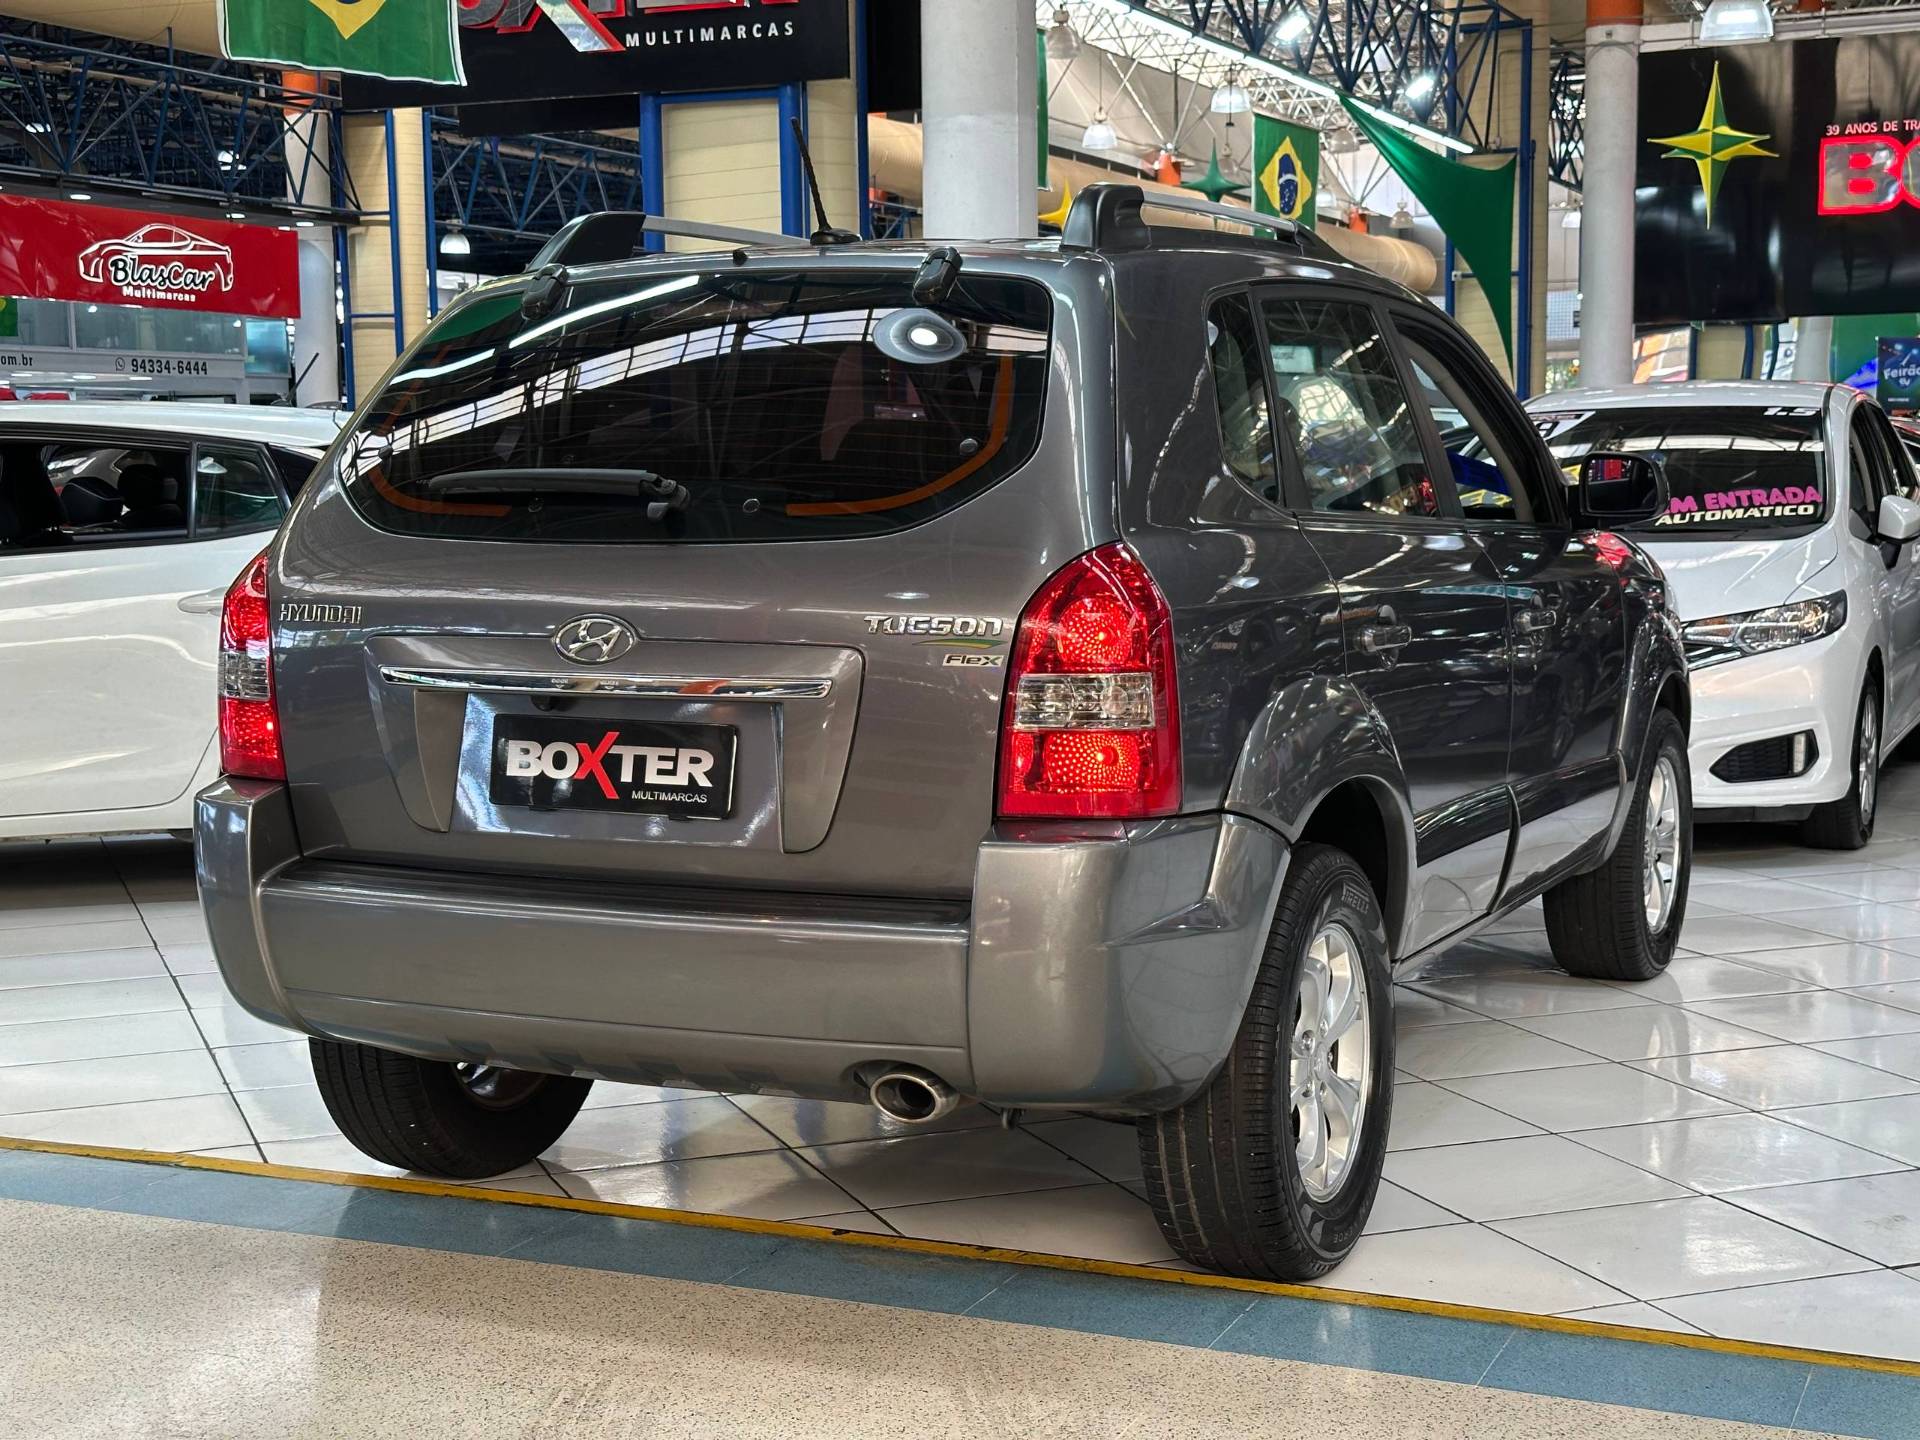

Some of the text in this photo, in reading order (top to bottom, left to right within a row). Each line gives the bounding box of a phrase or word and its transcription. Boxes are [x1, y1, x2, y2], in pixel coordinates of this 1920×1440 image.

[625, 21, 795, 47] MULTIMARCAS
[1826, 125, 1840, 136] 39
[1845, 122, 1878, 134] ANOS
[1883, 121, 1898, 132] DE
[109, 254, 215, 291] BlasCar
[122, 286, 196, 302] Multimarcas
[131, 358, 208, 375] 94334-6444
[1763, 407, 1820, 416] 1.5
[1664, 485, 1823, 514] M ENTRADA
[1655, 504, 1815, 526] AUTOMATICO
[279, 603, 362, 624] HYUNDAI
[863, 615, 1004, 637] TUCSON
[505, 731, 714, 799] BOXTER
[631, 790, 708, 803] MULTIMARCAS
